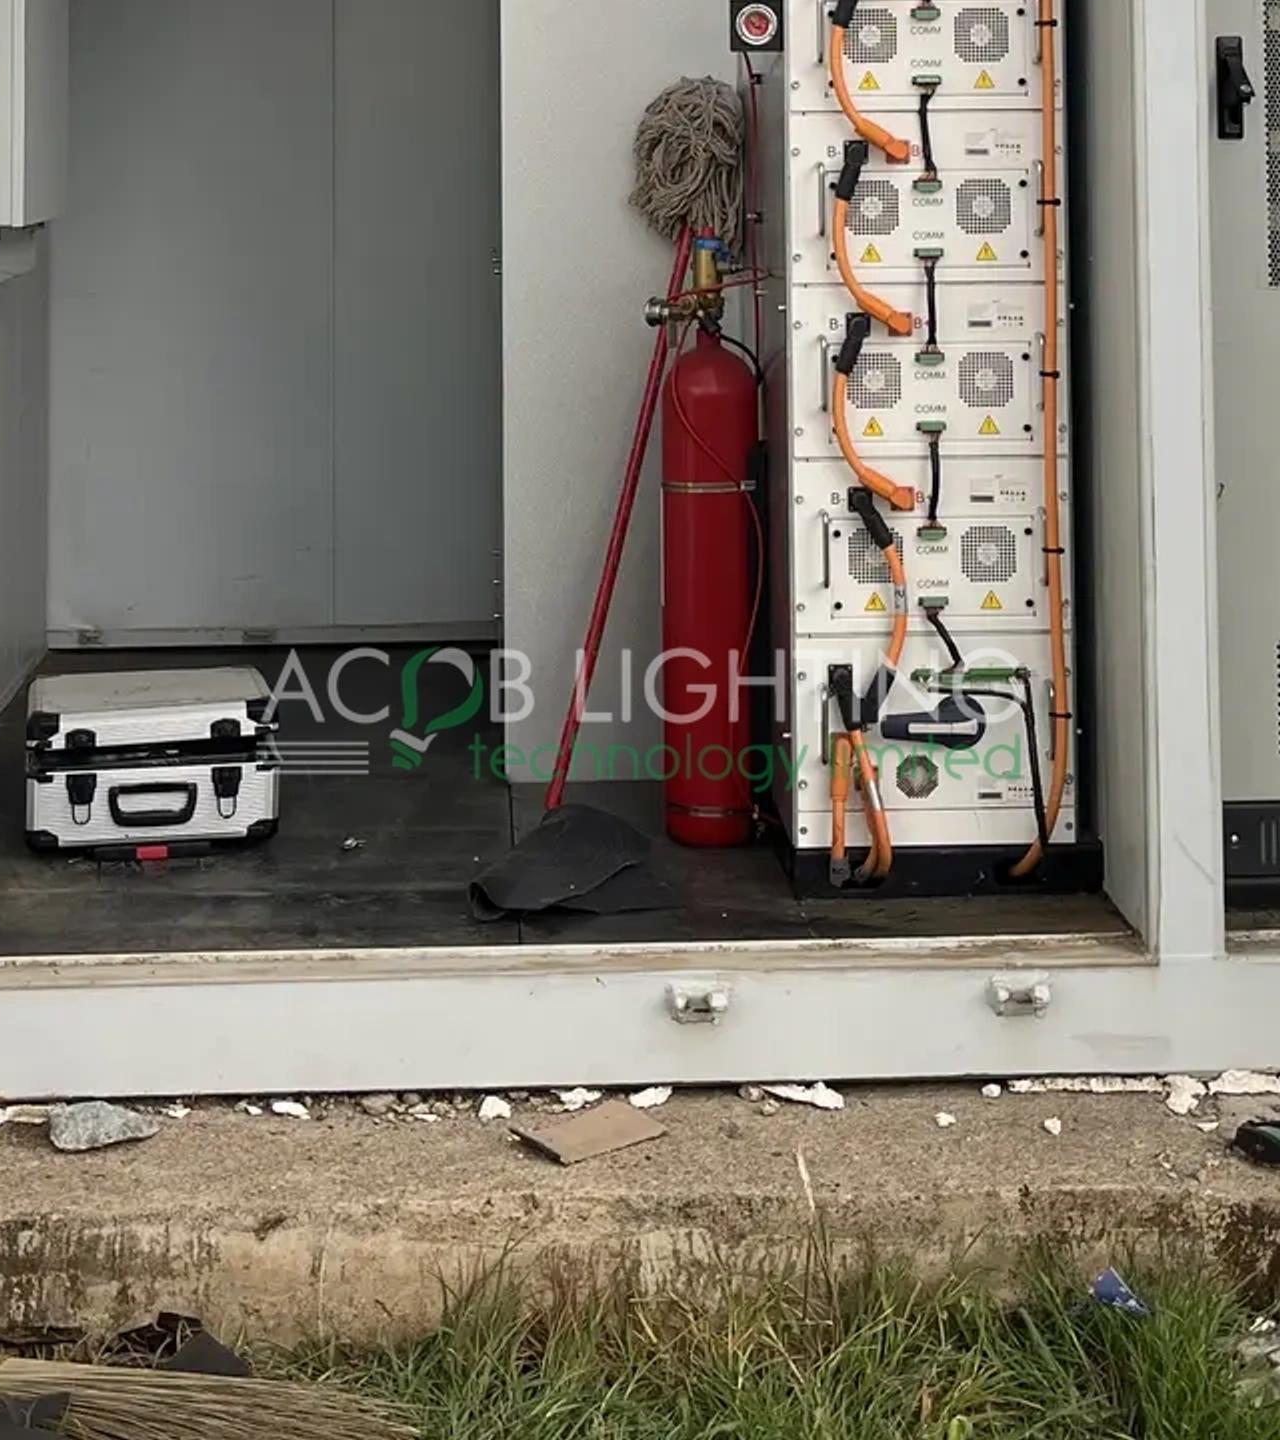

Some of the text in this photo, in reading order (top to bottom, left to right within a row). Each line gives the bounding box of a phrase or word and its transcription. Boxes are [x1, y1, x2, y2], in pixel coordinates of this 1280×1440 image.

[910, 26, 942, 35] COMM
[910, 59, 942, 68] COMM
[912, 197, 944, 207] COMM
[912, 231, 945, 240] COMM
[829, 318, 843, 331] B-
[914, 371, 946, 380] COMM
[915, 404, 948, 413] COMM
[916, 545, 949, 554] COMM
[917, 579, 950, 588] COMM
